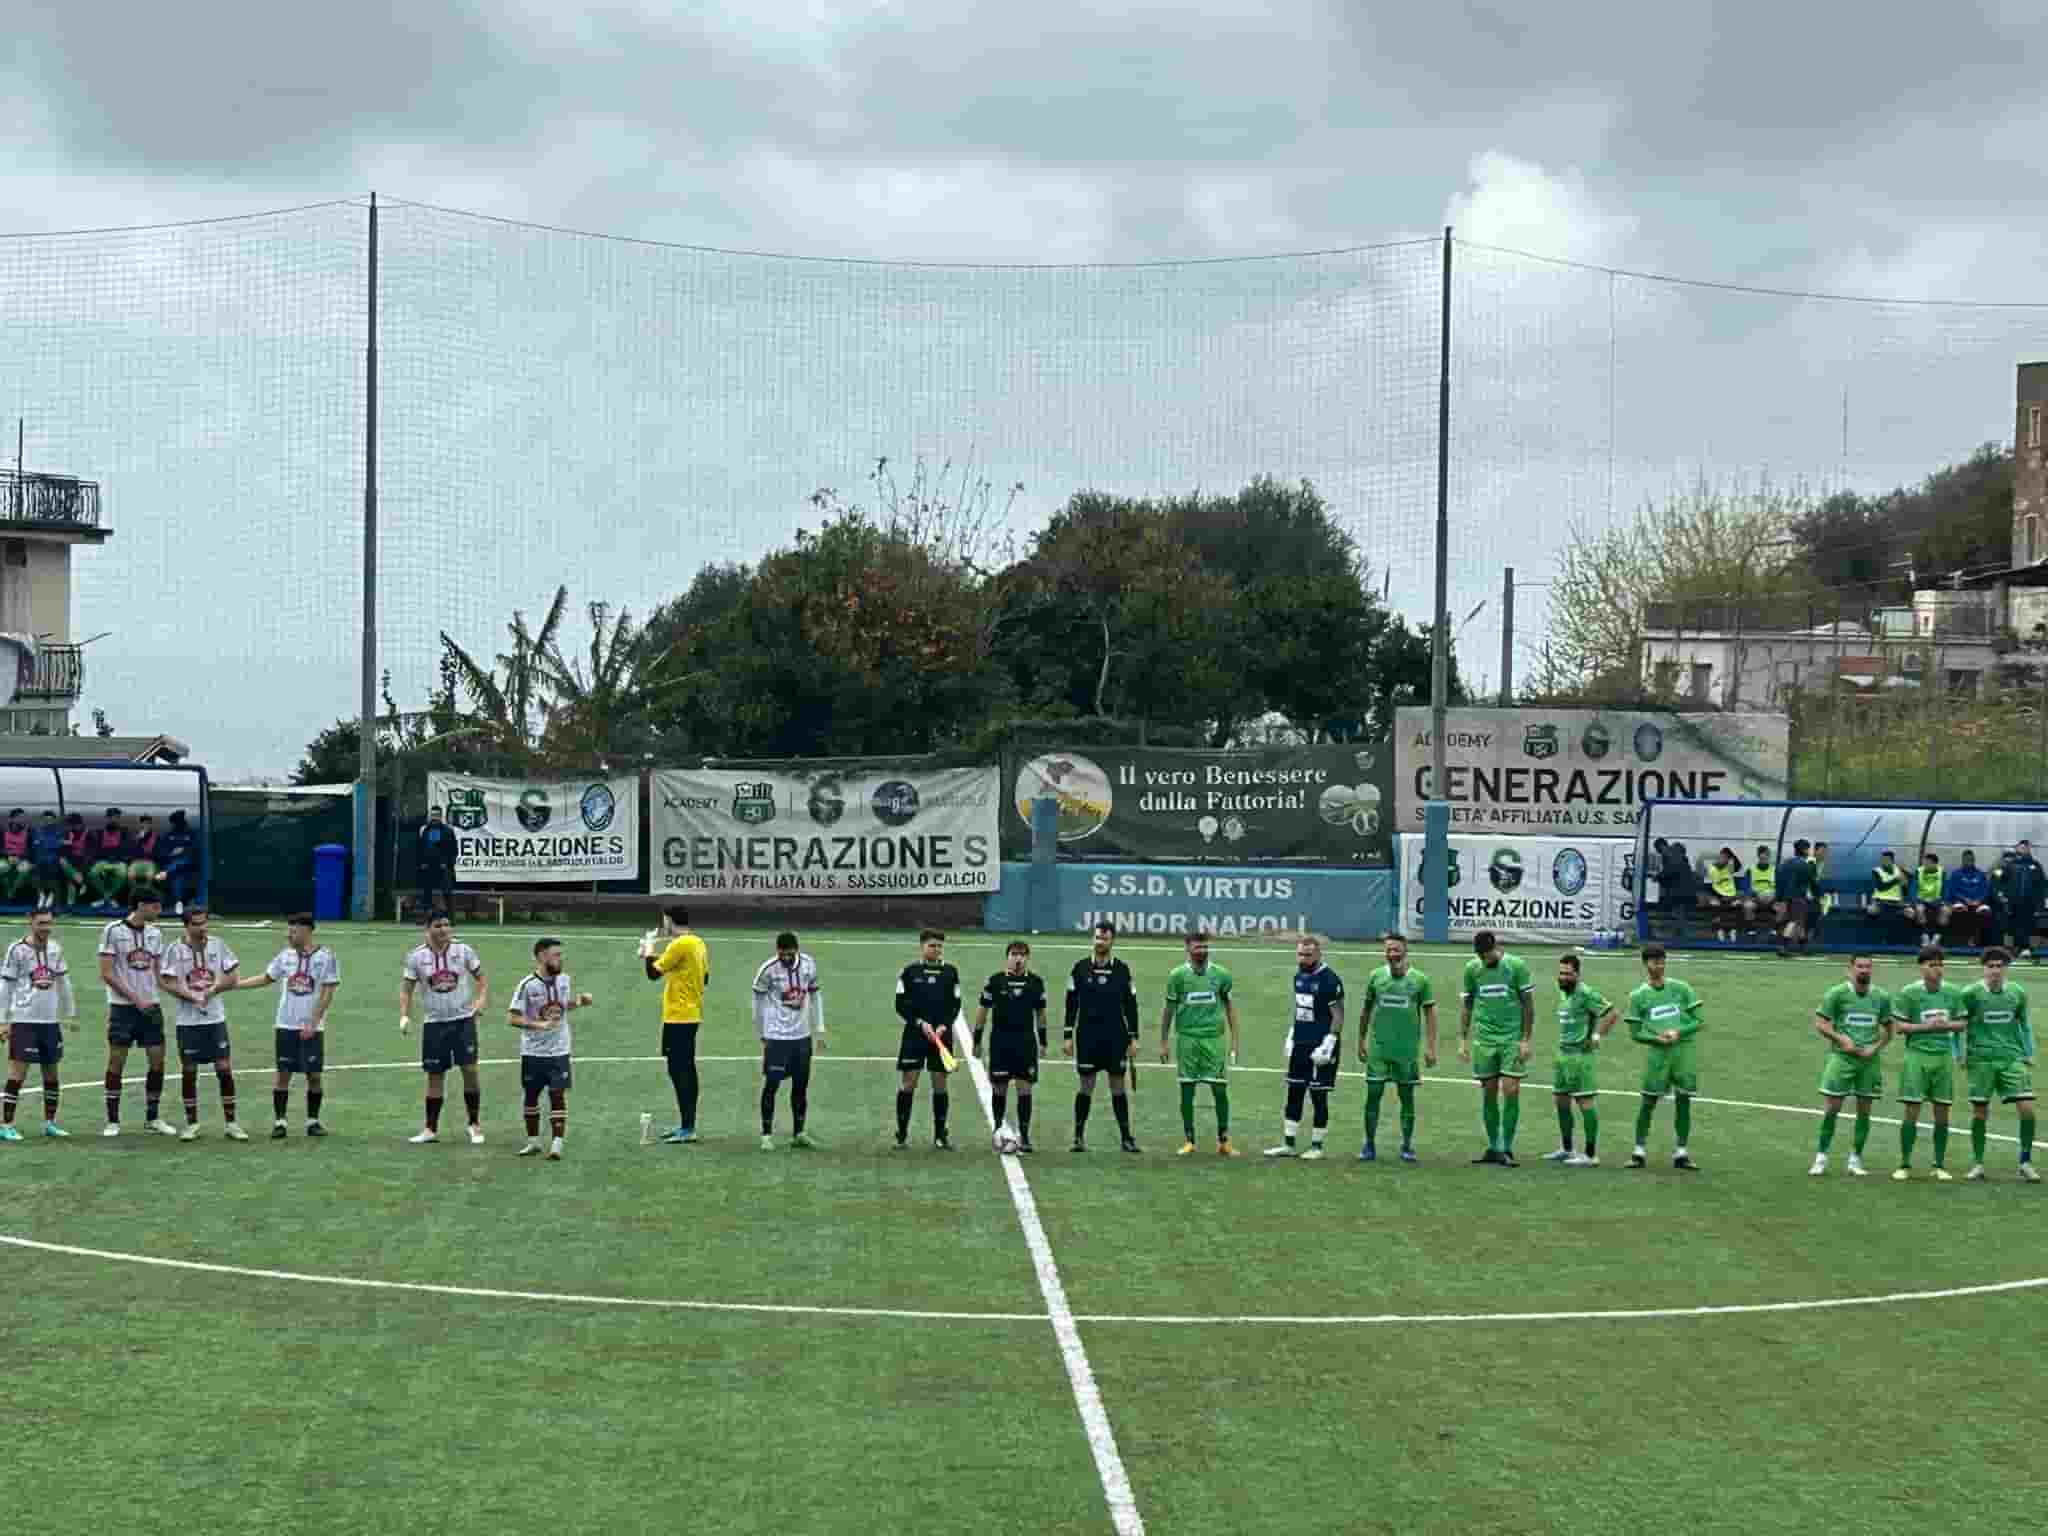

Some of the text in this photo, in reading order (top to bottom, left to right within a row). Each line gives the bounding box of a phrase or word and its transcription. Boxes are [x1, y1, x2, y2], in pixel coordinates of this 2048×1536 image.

[1415, 733, 1491, 748] ACDEMY
[1119, 765, 1328, 785] Il vero Benessere
[1207, 790, 1305, 810] Fattoria!
[1490, 808, 1572, 824] AFFILIATA
[459, 836, 624, 857] ENERAZIONE S
[664, 834, 988, 871] GENERAZIONE S
[731, 873, 805, 889] AFFILIATA
[847, 873, 929, 889] SASSUOLO
[933, 871, 986, 887] CALCIO
[1090, 873, 1293, 899] S.S.D. VIRTUS
[1579, 902, 1595, 920] S
[1075, 911, 1188, 934] JUNIOR
